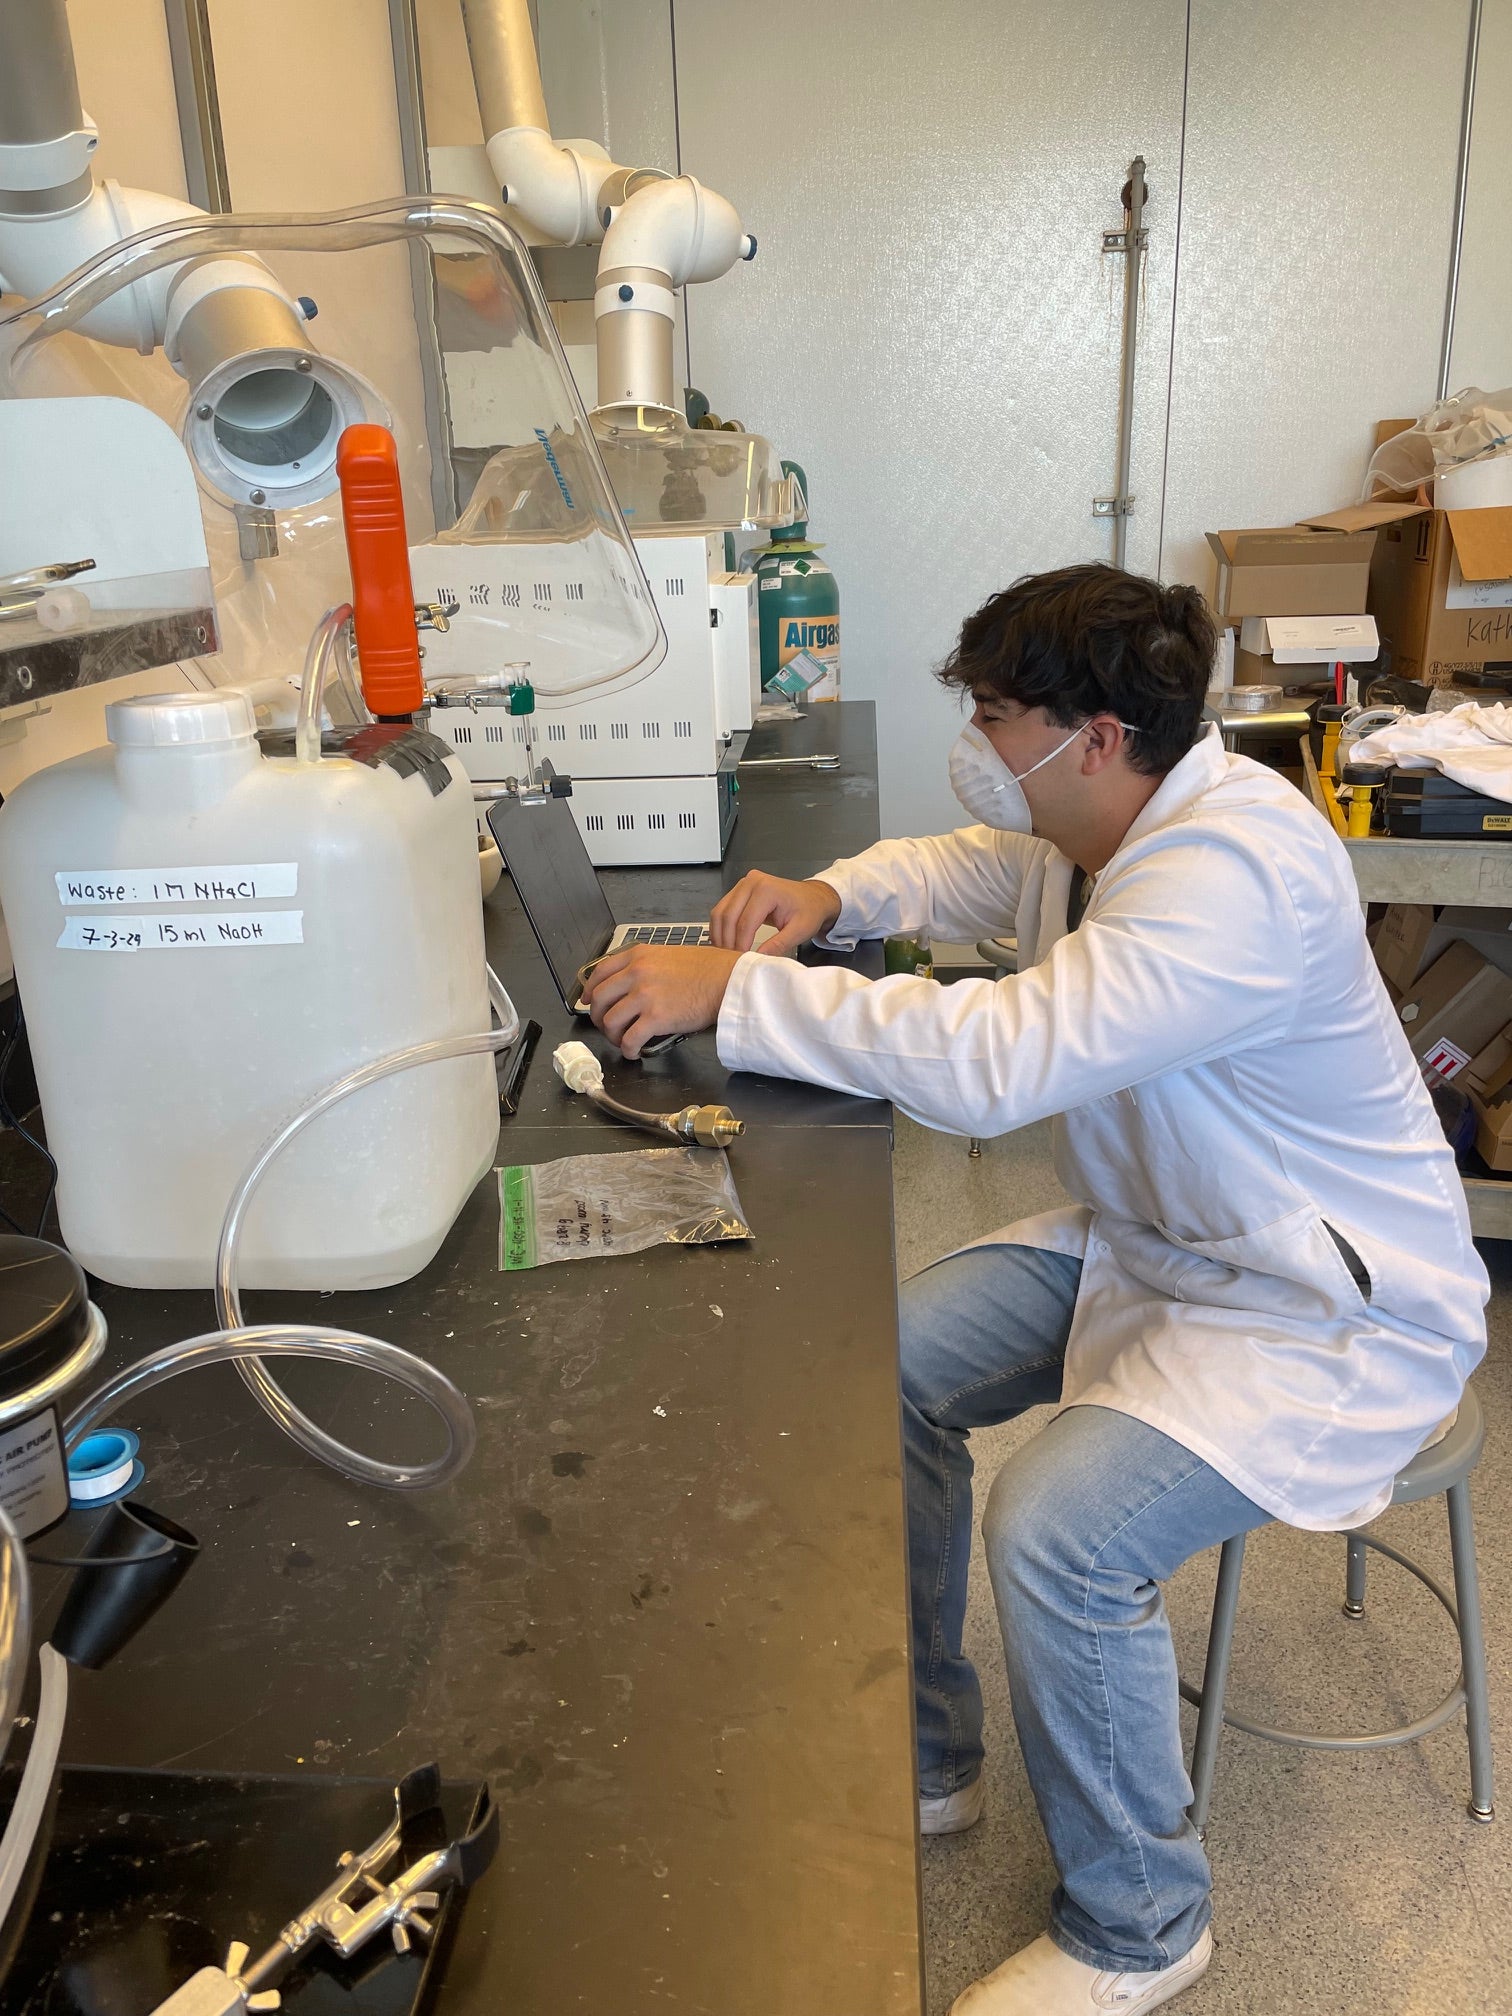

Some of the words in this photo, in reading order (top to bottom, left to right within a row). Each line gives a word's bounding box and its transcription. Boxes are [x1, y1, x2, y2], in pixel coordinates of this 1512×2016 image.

[784, 622, 840, 649] Airgas
[218, 923, 263, 941] NaOH
[5, 1446, 24, 1461] AIR
[26, 1427, 52, 1450] PUMP
